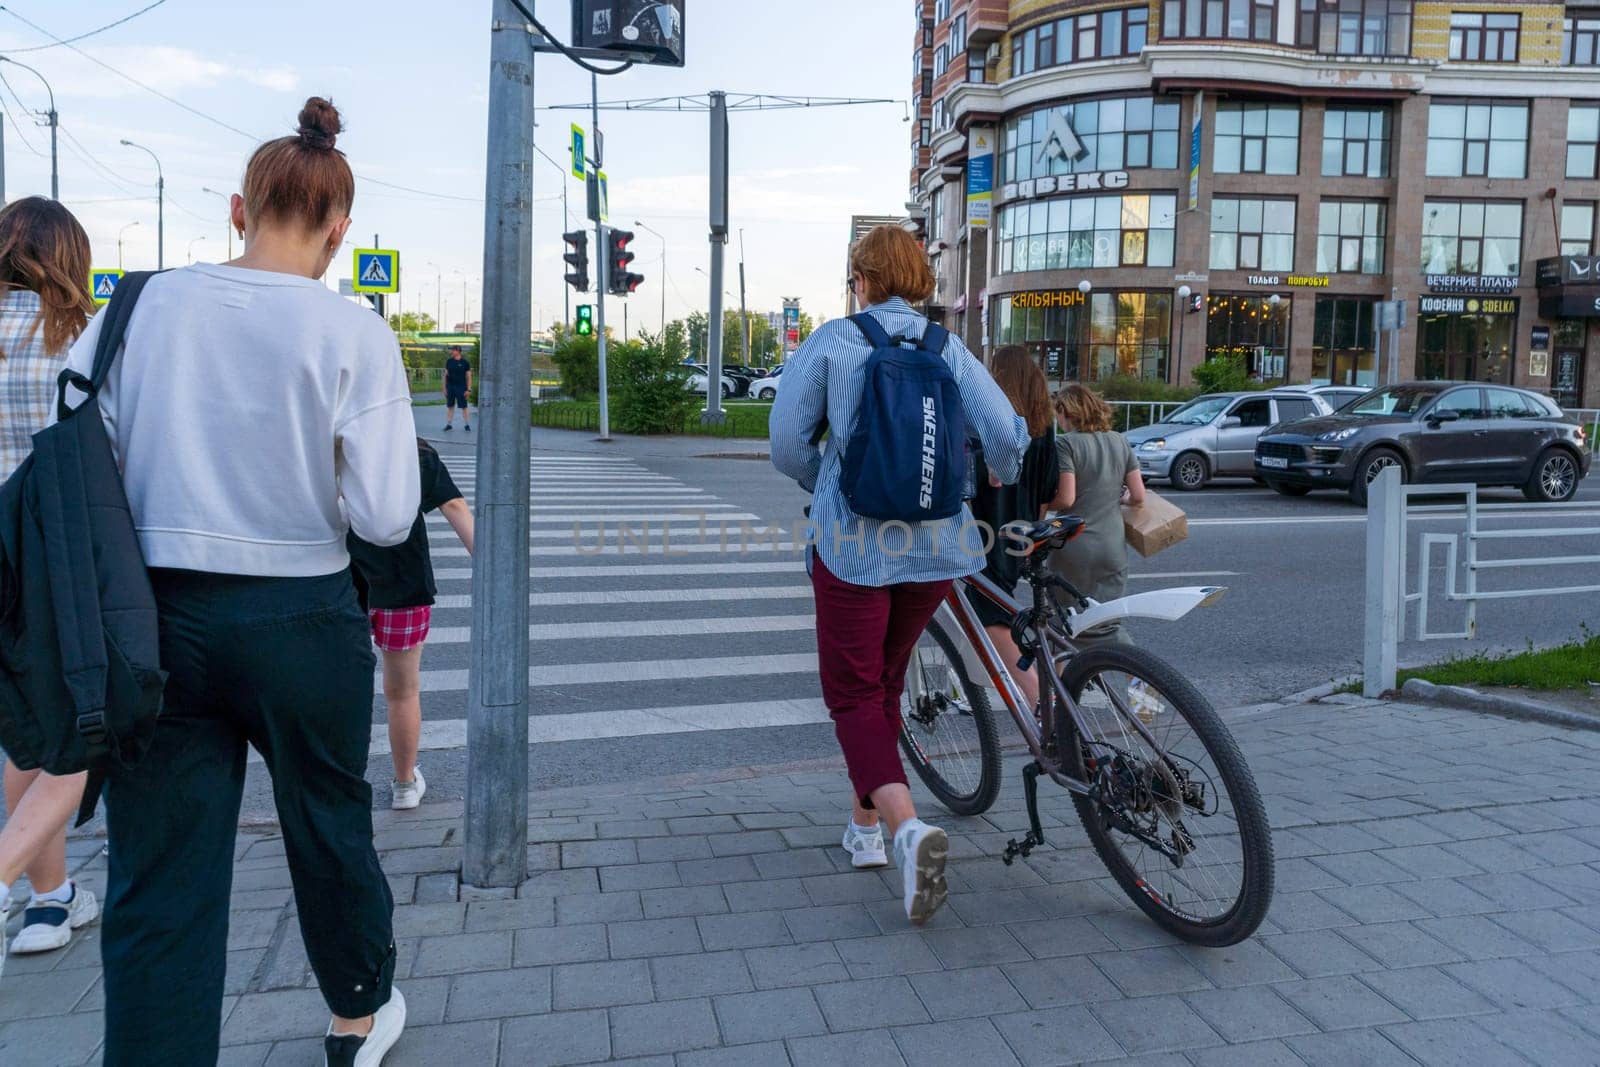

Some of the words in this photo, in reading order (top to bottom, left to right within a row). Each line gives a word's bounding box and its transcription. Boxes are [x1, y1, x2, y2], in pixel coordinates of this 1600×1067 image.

[1030, 237, 1110, 255] GABBANO
[1248, 275, 1279, 285] ТОЛЬКО
[1287, 274, 1329, 287] ПОПРОБУЙ
[1427, 275, 1477, 287] ВЕЧЕРНИЕ
[1480, 276, 1518, 288] ПЛАТЬЯ
[1011, 291, 1085, 307] КАЛЬЯНЫЧ
[1421, 297, 1464, 313] КОФЕЙНЯ
[1482, 299, 1515, 313] SDELKA
[919, 396, 937, 510] SKECHERS
